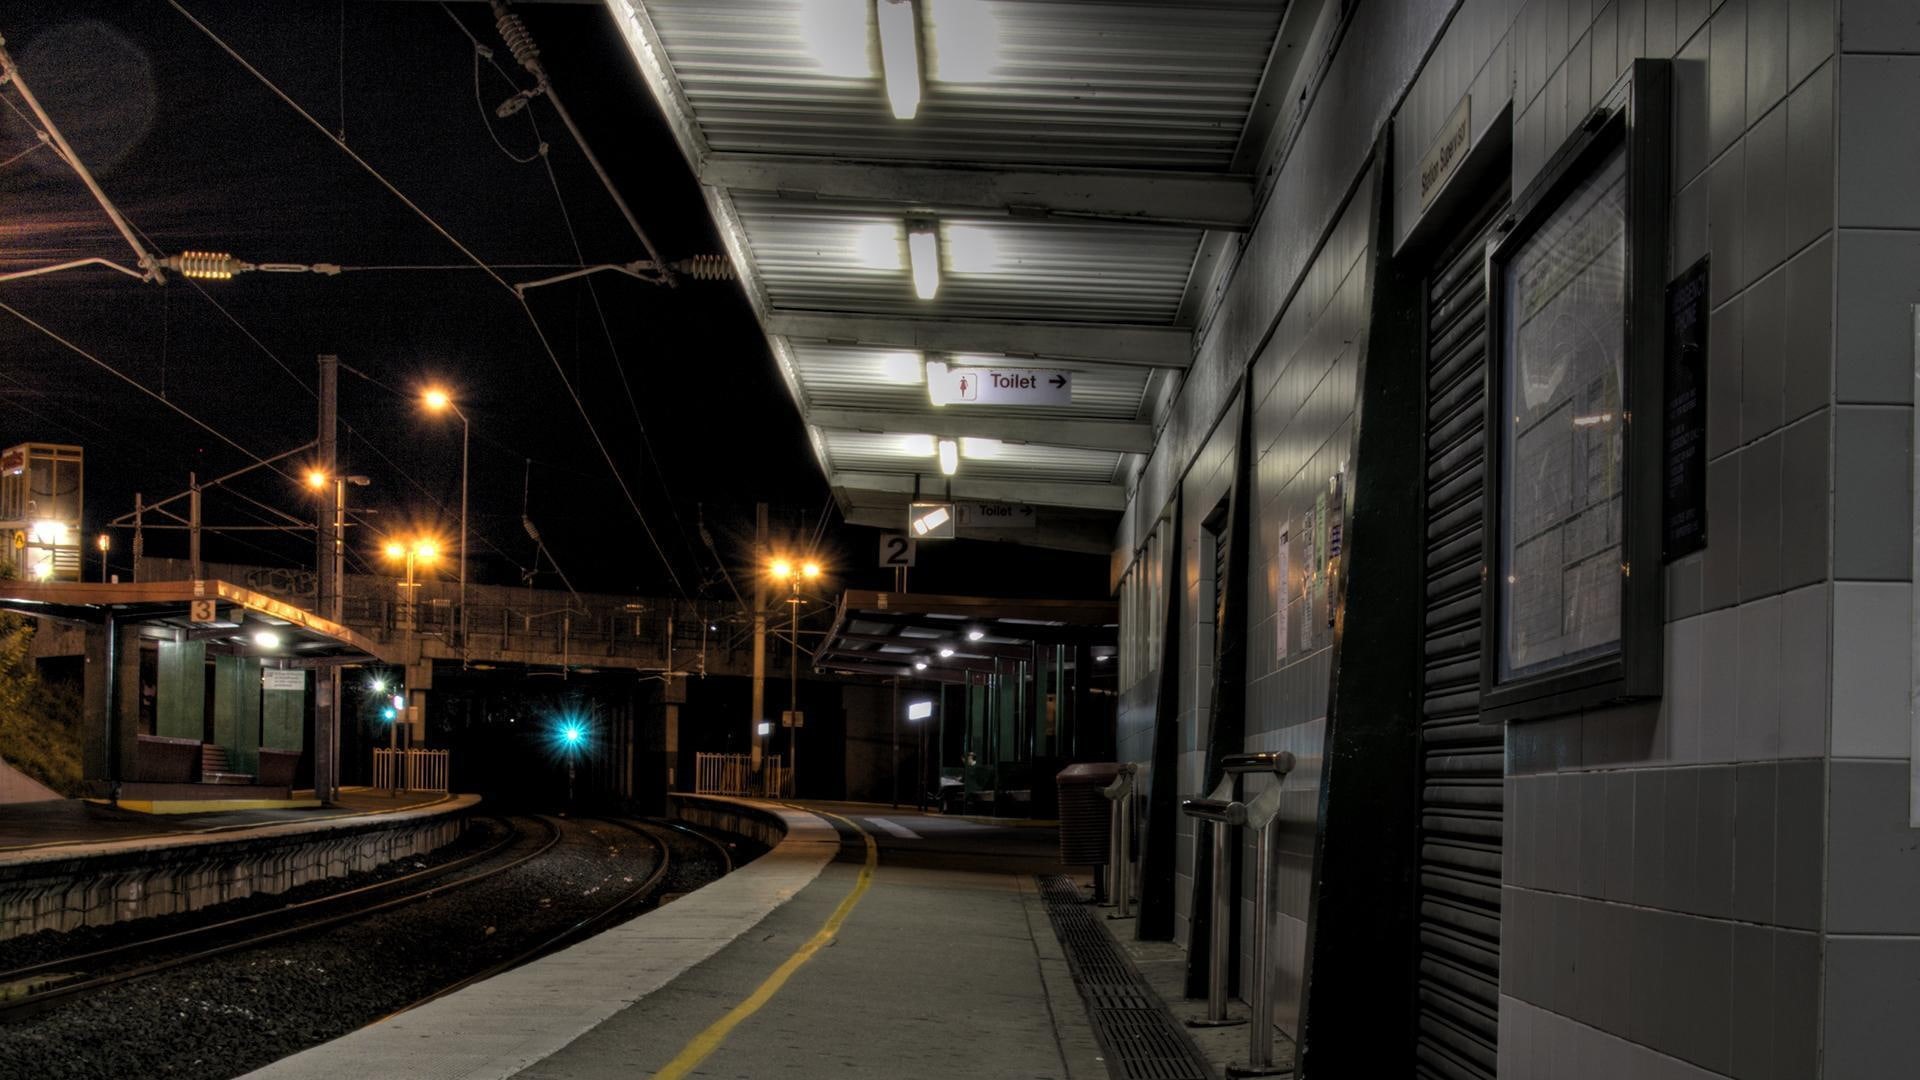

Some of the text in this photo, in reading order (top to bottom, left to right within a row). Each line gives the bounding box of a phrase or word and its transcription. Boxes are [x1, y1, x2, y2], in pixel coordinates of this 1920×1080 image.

[990, 373, 1036, 388] Toilet
[979, 504, 1011, 515] Toilet
[887, 537, 908, 563] 2
[195, 600, 210, 619] 3
